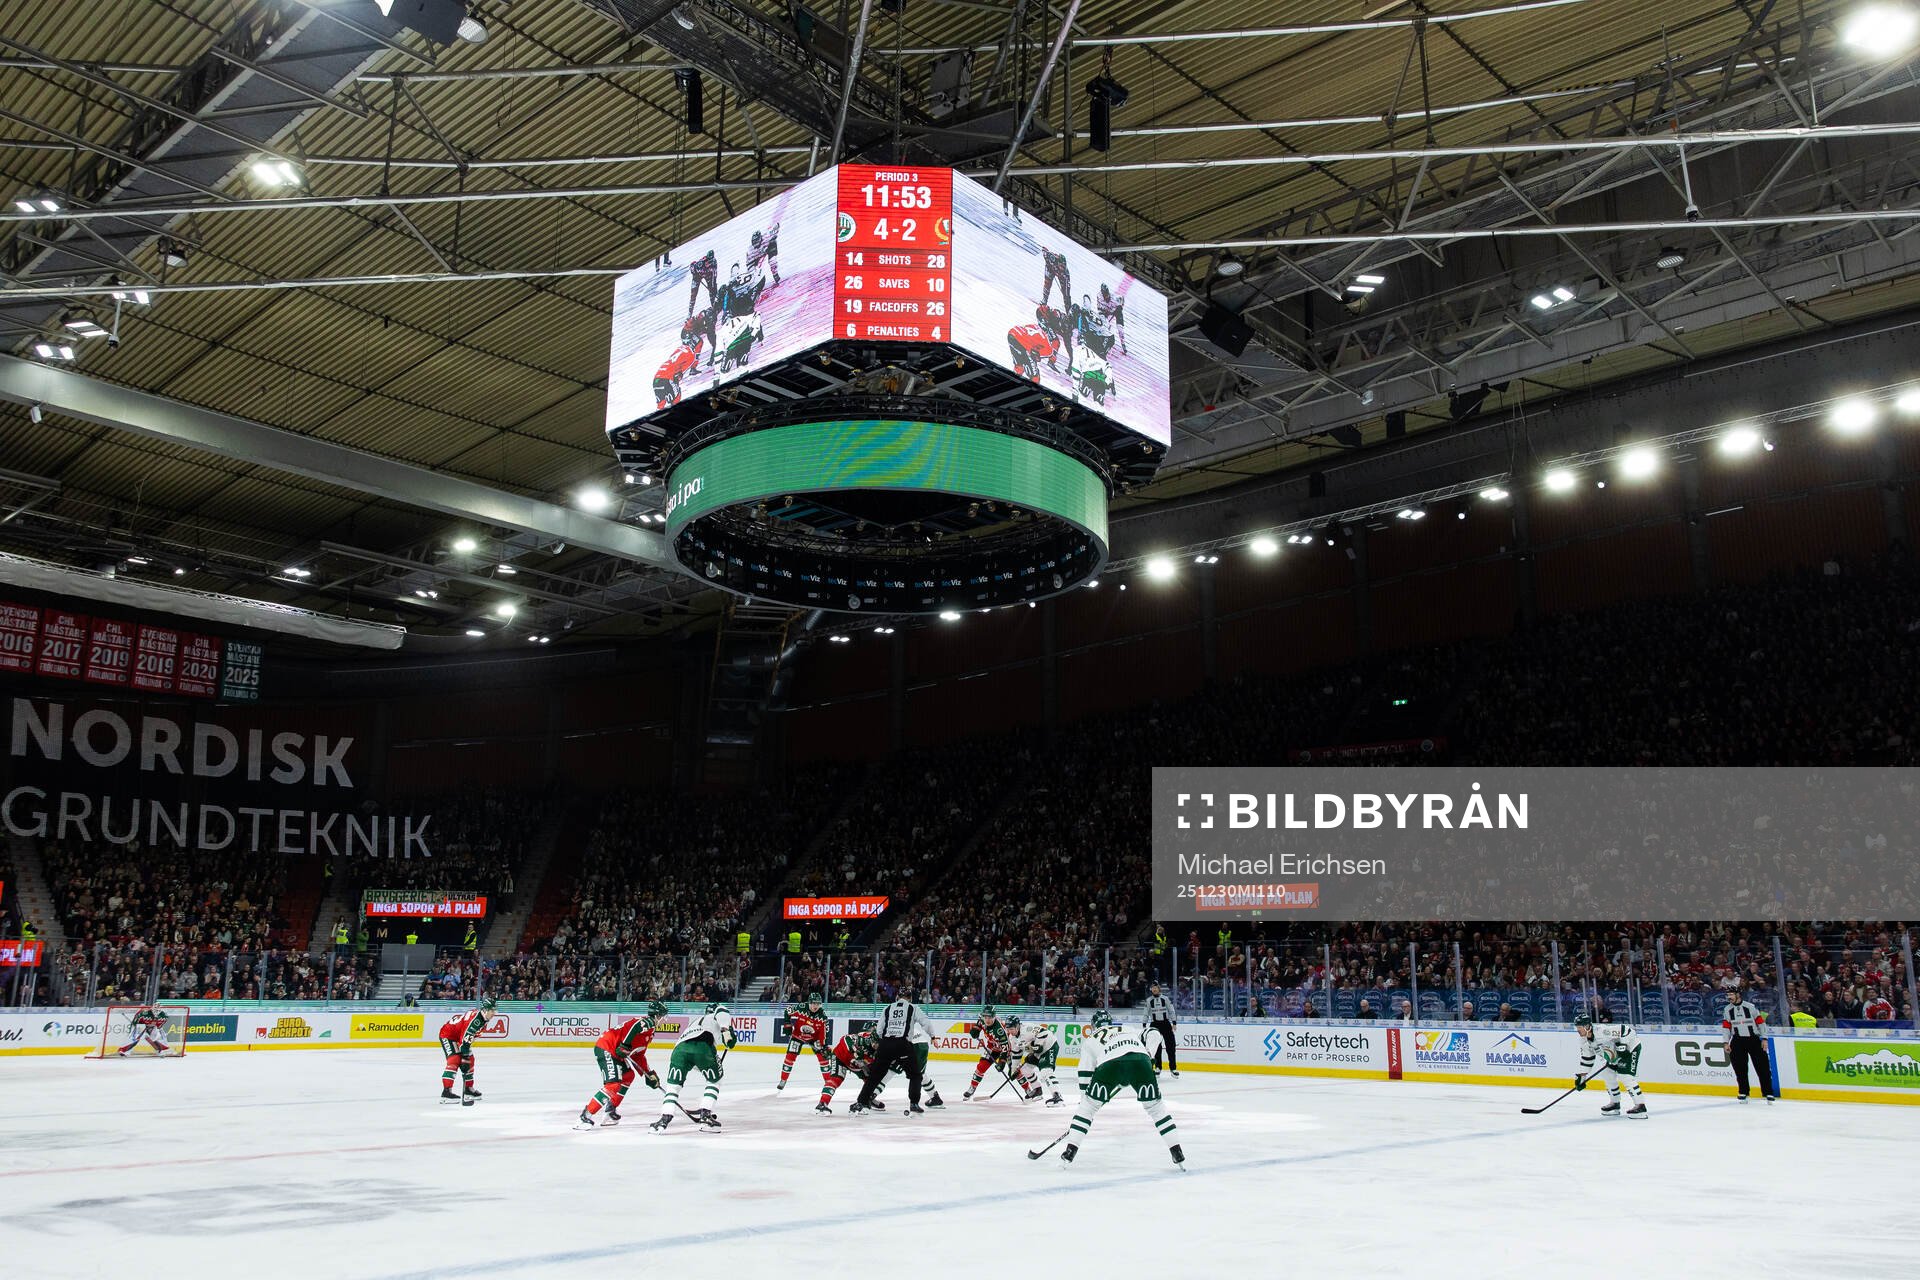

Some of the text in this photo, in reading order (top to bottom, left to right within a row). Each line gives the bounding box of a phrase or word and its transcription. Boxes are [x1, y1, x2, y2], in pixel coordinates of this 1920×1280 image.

[875, 172, 918, 182] PERIOD 3
[861, 184, 931, 208] 11:53
[845, 252, 945, 268] 14 SHOTS 28
[844, 276, 944, 292] 26 SAVES 10
[844, 299, 944, 315] 19 FACEOFFS 26
[846, 324, 941, 339] 6 PENALTIES 4
[58, 615, 75, 626] CHL
[106, 623, 123, 634] CHL
[42, 639, 82, 660] 2017
[90, 646, 130, 667] 2019
[137, 653, 174, 674] 2019
[182, 661, 217, 679] 2020
[224, 666, 260, 685] 2025
[10, 697, 354, 788] NORDISK
[1, 785, 432, 859] GRUNDTEKNIK
[372, 900, 481, 915] INGA SOPOR PÅ PLAN
[788, 901, 884, 916] INGA SOPOR PÅ PLAN
[376, 928, 388, 938] M
[893, 1010, 904, 1018] 93
[168, 1023, 226, 1034] Assemblin
[277, 1017, 305, 1028] EURO
[368, 1022, 419, 1032] Ramudden
[542, 1017, 590, 1027] NORDIC
[731, 1017, 757, 1029] NTER
[268, 1026, 312, 1038] JACKPOT
[531, 1027, 600, 1037] WELLNESS
[733, 1031, 756, 1042] PORT
[1104, 1039, 1140, 1054] Helmia
[1183, 1034, 1235, 1048] SERVICE
[1286, 1032, 1369, 1052] Safetytech
[1286, 1052, 1308, 1060] PART
[1326, 1054, 1370, 1063] PROSERO
[1415, 1051, 1471, 1062] HAGMANS
[1486, 1053, 1547, 1065] HAGMANS
